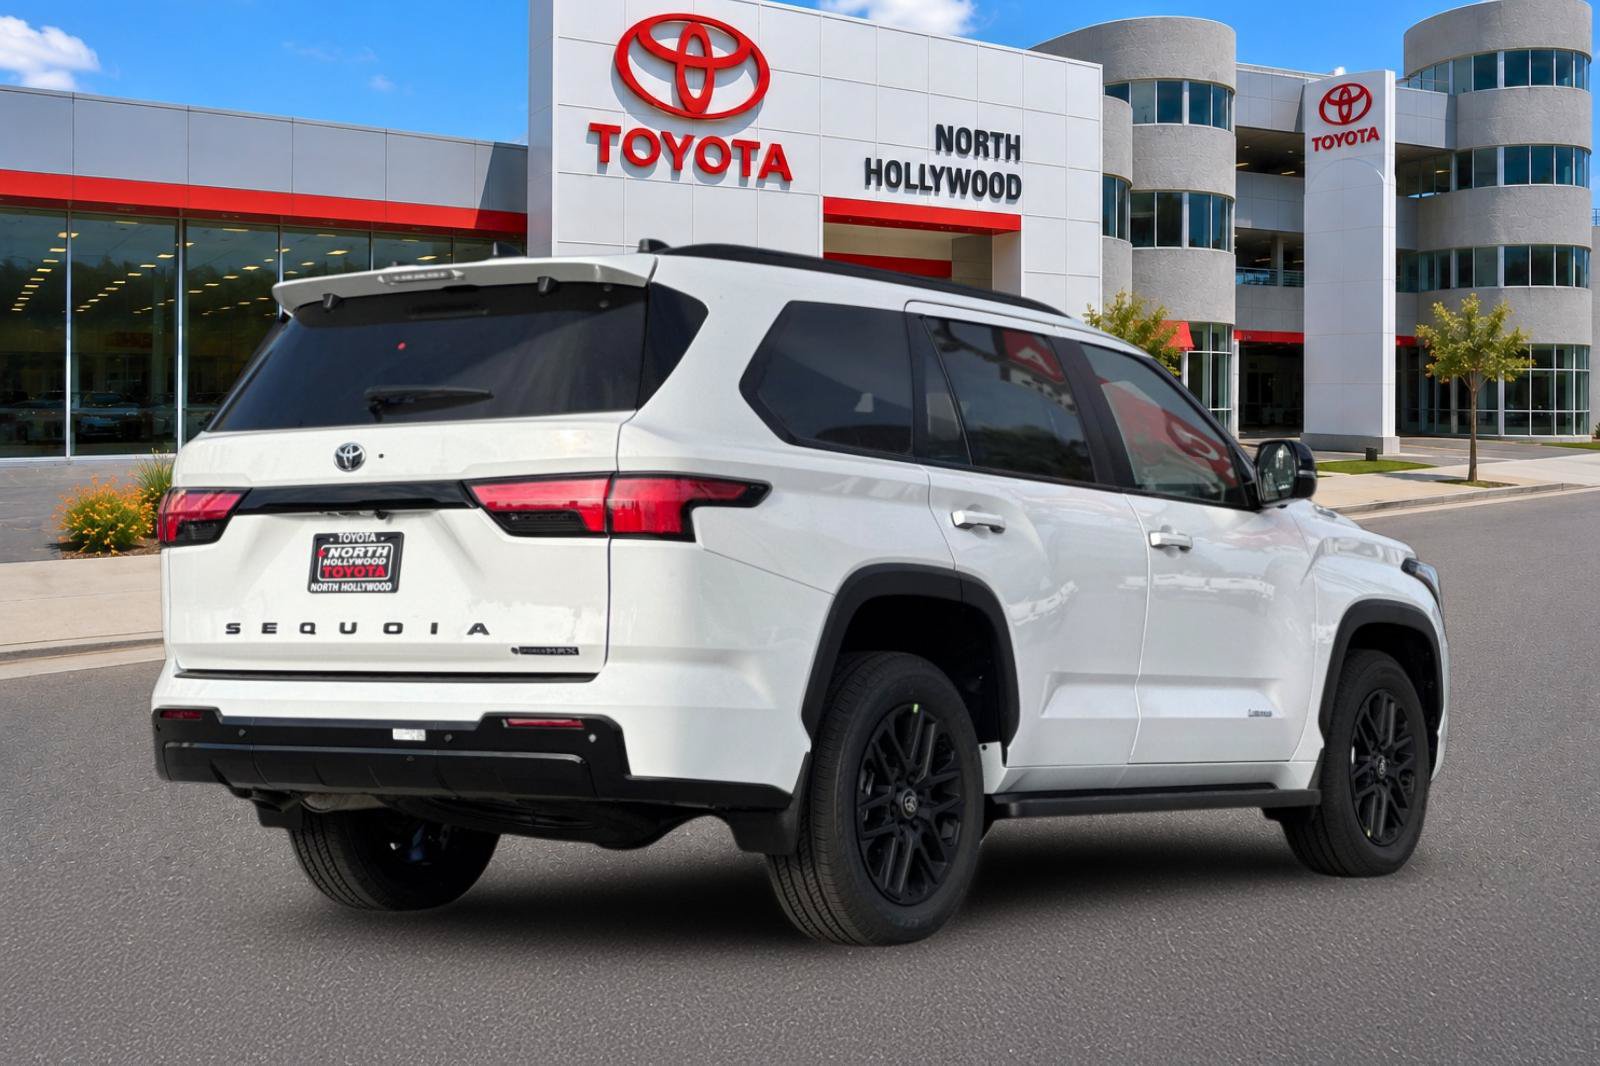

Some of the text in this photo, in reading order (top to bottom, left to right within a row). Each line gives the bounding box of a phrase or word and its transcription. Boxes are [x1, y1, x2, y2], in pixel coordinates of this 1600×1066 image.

[935, 123, 1021, 161] NORTH
[1311, 126, 1380, 152] TOYOTA
[589, 122, 793, 182] TOYOTA
[865, 157, 1022, 200] HOLLYWOOD
[337, 532, 377, 543] TOYOTA
[327, 546, 390, 558] NORTH
[322, 557, 387, 566] HOLLYWOOD
[322, 565, 386, 578] TOYOTA
[310, 582, 392, 592] NORTH HOLLYWOOD
[225, 621, 490, 636] SEQUOIA
